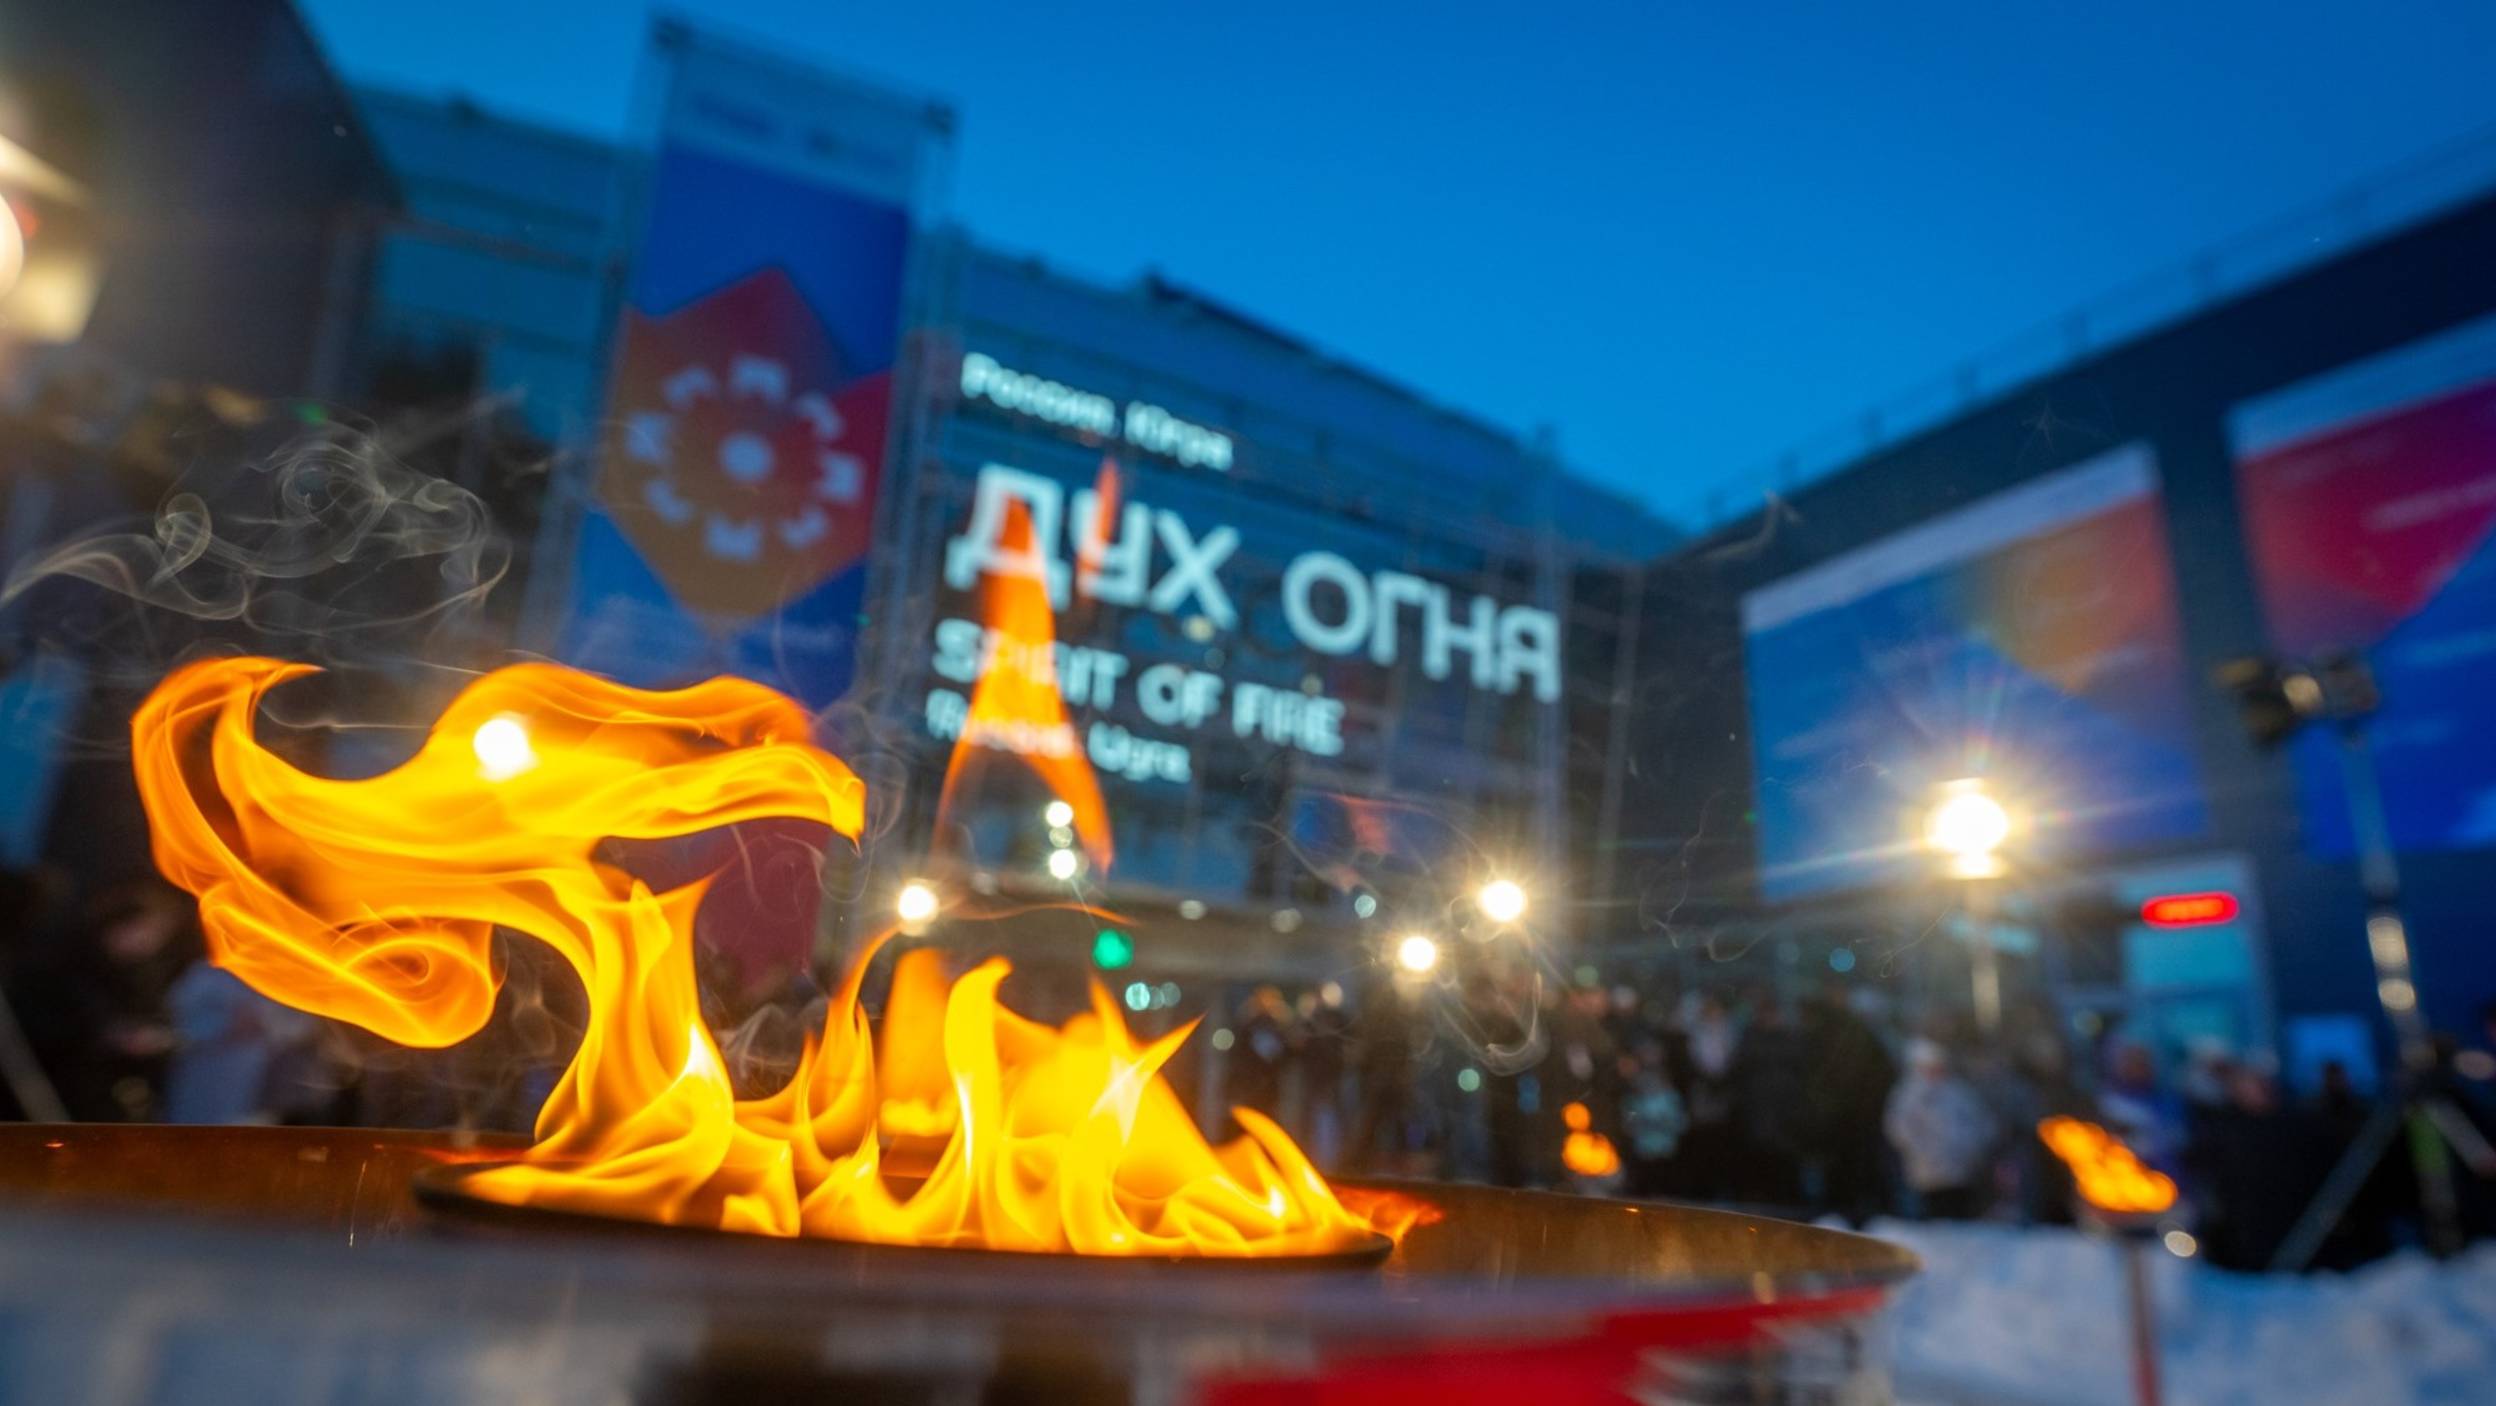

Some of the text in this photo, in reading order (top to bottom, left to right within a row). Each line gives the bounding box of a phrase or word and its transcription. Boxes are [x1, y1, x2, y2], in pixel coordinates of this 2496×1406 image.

[944, 463, 1563, 701] ДУХ ОГНЯ
[1136, 663, 1225, 729] OF
[1232, 682, 1346, 757] FIRE
